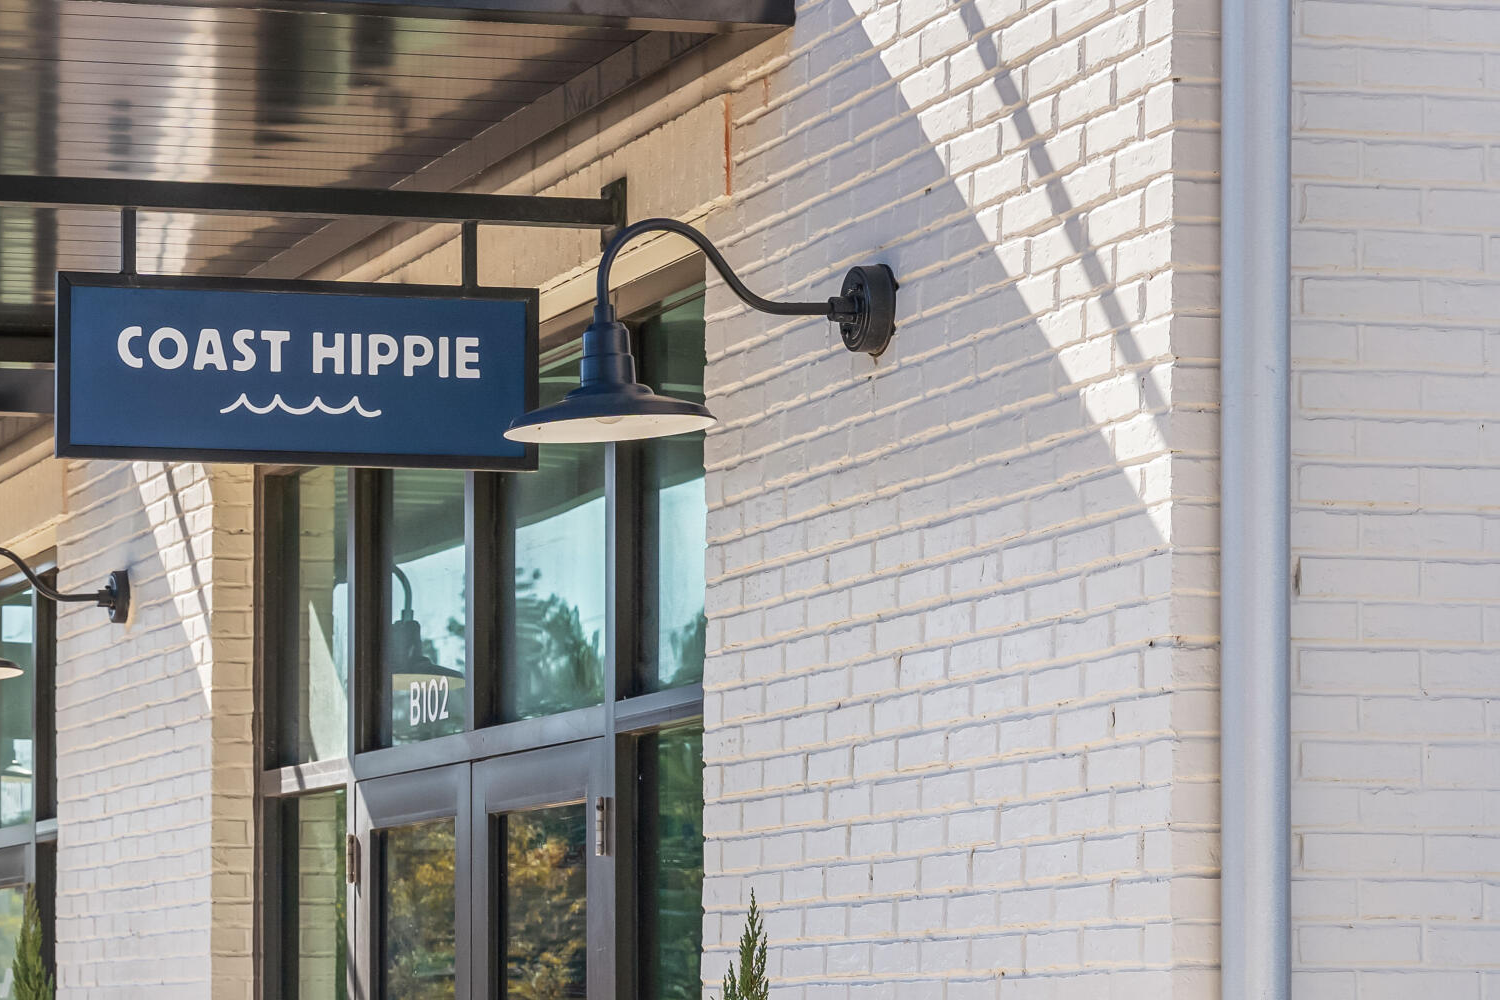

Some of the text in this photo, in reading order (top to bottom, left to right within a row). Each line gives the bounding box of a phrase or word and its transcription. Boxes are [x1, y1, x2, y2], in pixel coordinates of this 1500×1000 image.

[117, 326, 481, 379] COAST HIPPIE
[410, 675, 449, 726] B102
